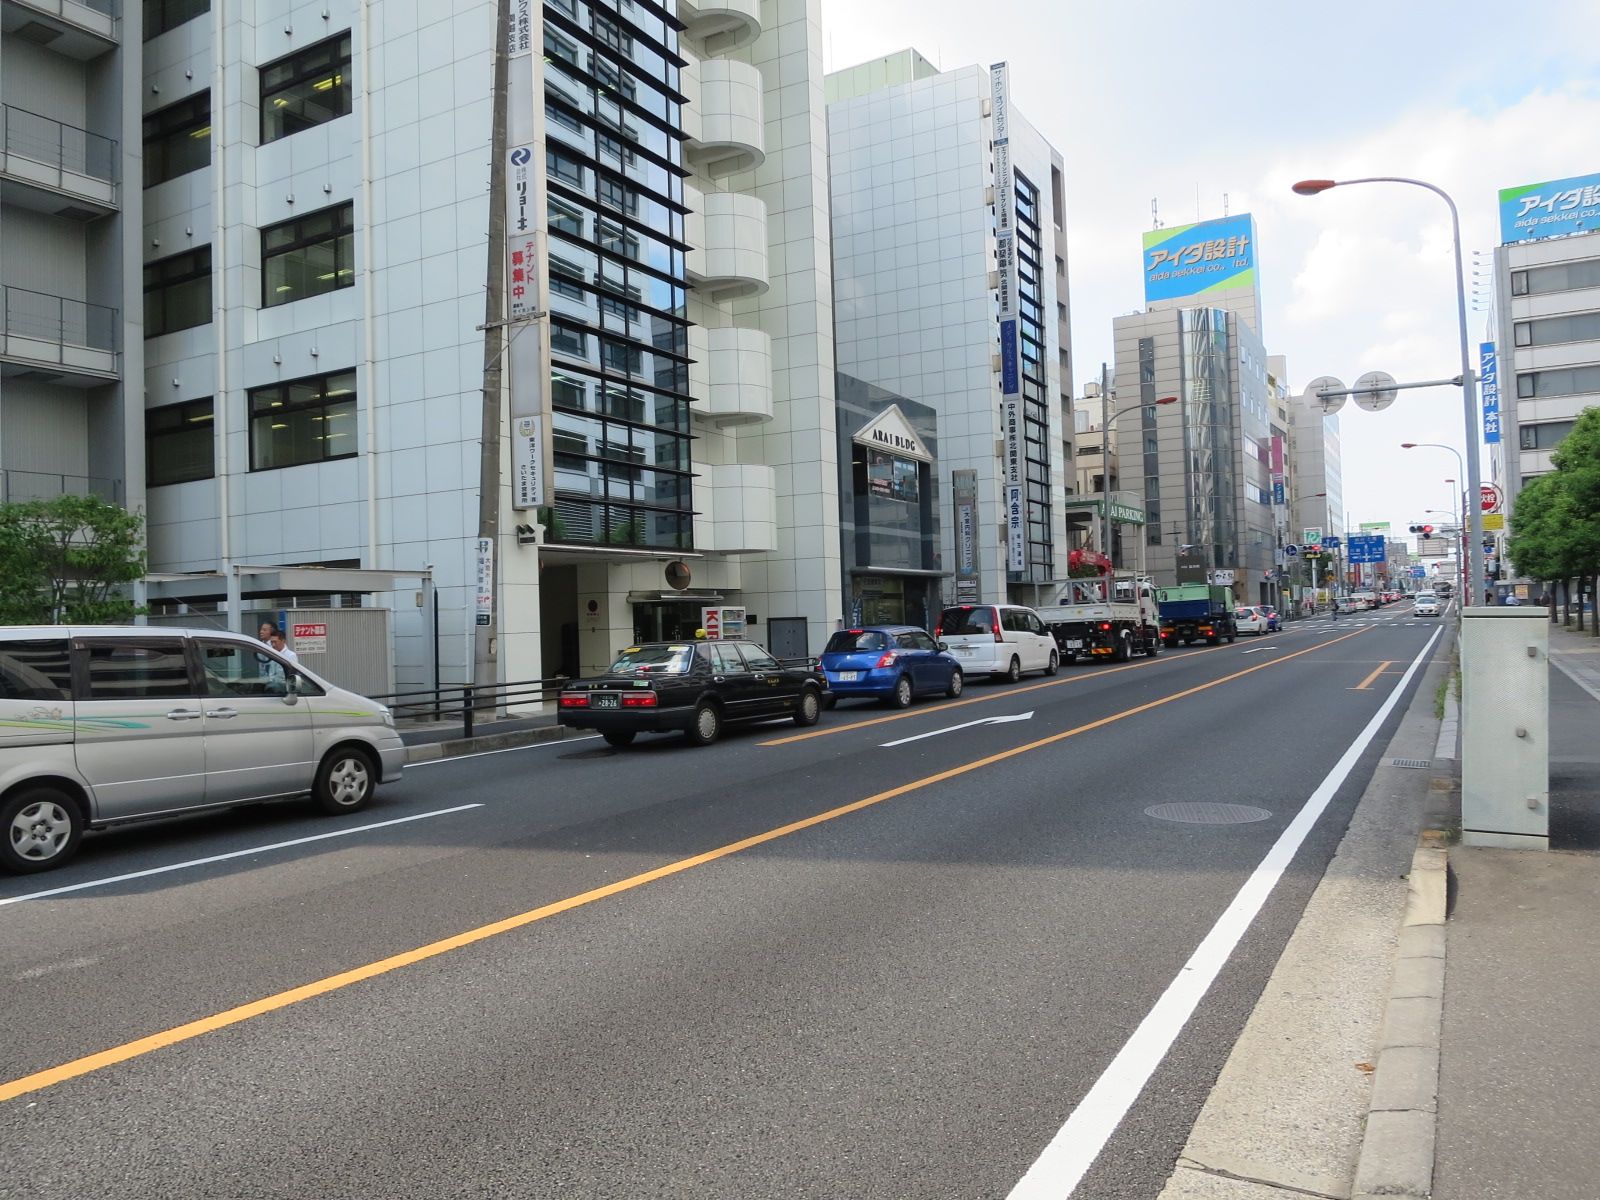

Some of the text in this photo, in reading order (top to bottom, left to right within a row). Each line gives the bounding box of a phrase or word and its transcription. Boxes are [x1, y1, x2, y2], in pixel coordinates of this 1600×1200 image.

[516, 181, 528, 231] リョーキ
[511, 250, 525, 300] 募集中
[525, 241, 535, 285] テナント
[1147, 235, 1249, 272] アイダ設計
[1482, 352, 1498, 434] アイダ設計 本社
[872, 428, 916, 452] ARAI BLDG
[1118, 506, 1144, 522] PARKING
